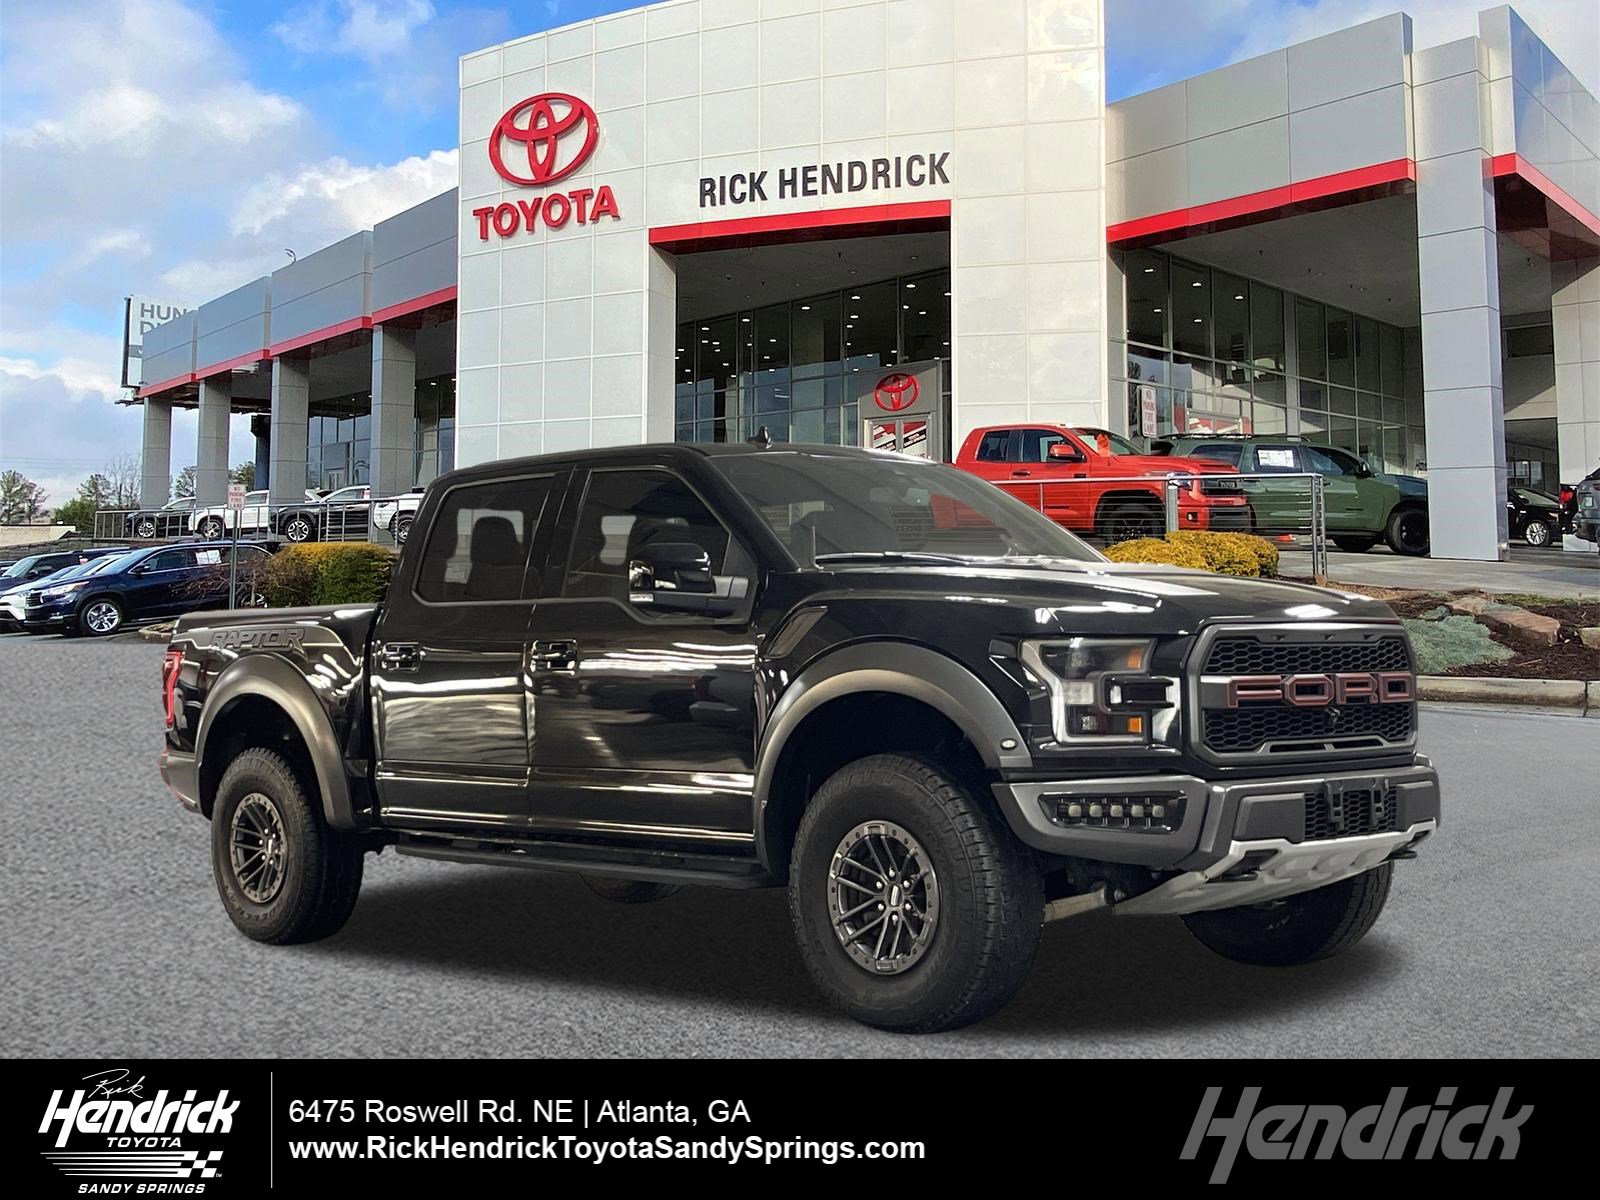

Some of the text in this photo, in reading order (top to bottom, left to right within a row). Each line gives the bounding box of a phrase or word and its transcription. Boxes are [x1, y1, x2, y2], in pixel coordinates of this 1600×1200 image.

[699, 152, 951, 208] RICK HENDRICK
[472, 184, 621, 241] TOYOTA
[211, 628, 305, 654] RAPTOR
[1225, 671, 1415, 709] FORD
